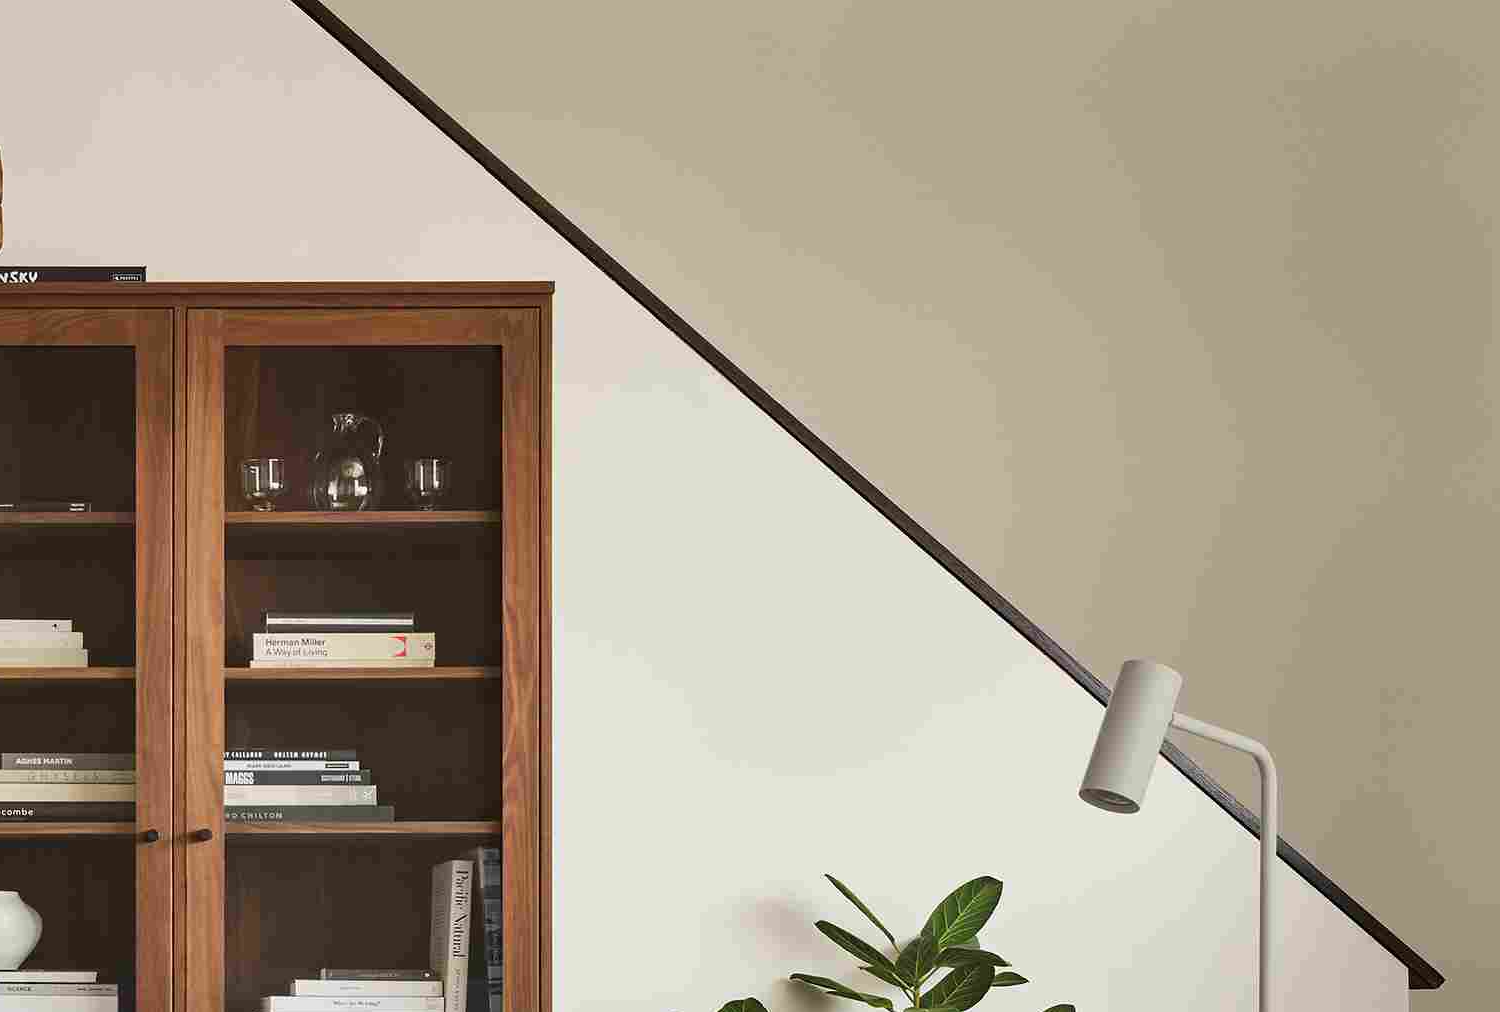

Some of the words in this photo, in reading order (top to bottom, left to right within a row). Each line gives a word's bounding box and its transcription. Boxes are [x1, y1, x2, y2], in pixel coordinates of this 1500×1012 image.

[265, 638, 299, 646] Herman
[301, 638, 326, 646] Miller
[225, 772, 255, 785] MAGGS
[454, 869, 469, 909] Pacific
[452, 914, 468, 959] Natural
